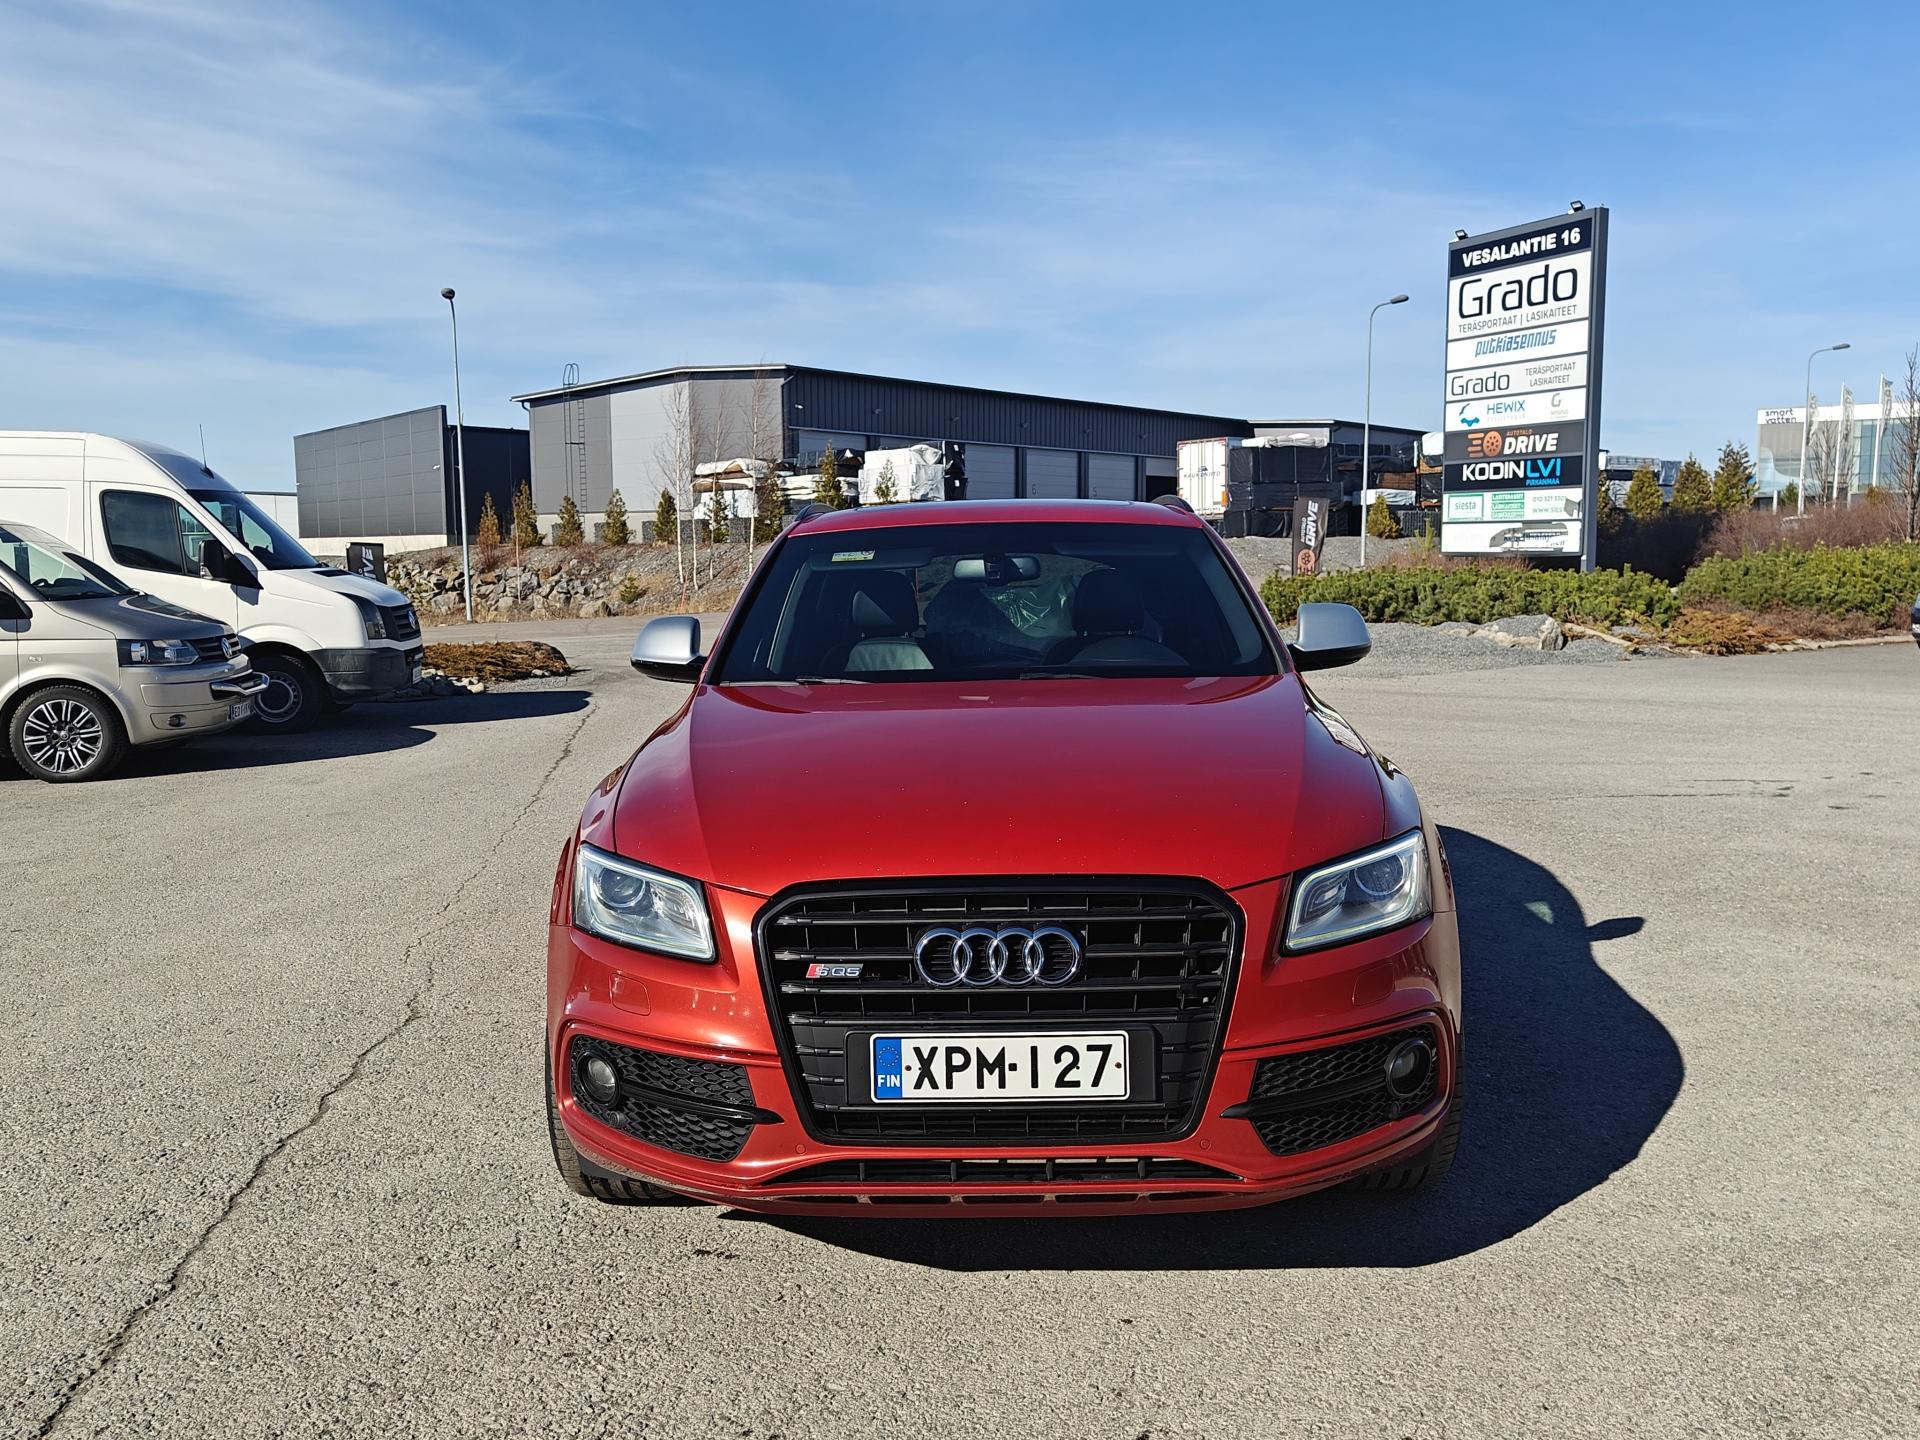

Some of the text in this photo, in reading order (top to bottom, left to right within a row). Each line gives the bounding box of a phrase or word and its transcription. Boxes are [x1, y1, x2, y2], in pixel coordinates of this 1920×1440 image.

[1462, 228, 1580, 267] VESALANTIE 16
[1458, 264, 1578, 319] Grado
[1458, 304, 1577, 333] TERÄSPORTAAT LASIKAITEET
[1474, 329, 1557, 358] putkiasennus
[1525, 362, 1576, 376] TERÄSPORTAAT
[1451, 371, 1510, 396] Grado
[1529, 374, 1570, 387] LASIKAITEET
[1487, 400, 1525, 415] HEWIX
[1765, 408, 1793, 416] smart
[1503, 433, 1559, 455] DRIVE
[1455, 501, 1476, 510] siesta
[1305, 500, 1319, 547] DRIVE
[814, 966, 860, 976] SQ5
[913, 1044, 1113, 1089] XPM-127
[877, 1074, 900, 1087] FIN
